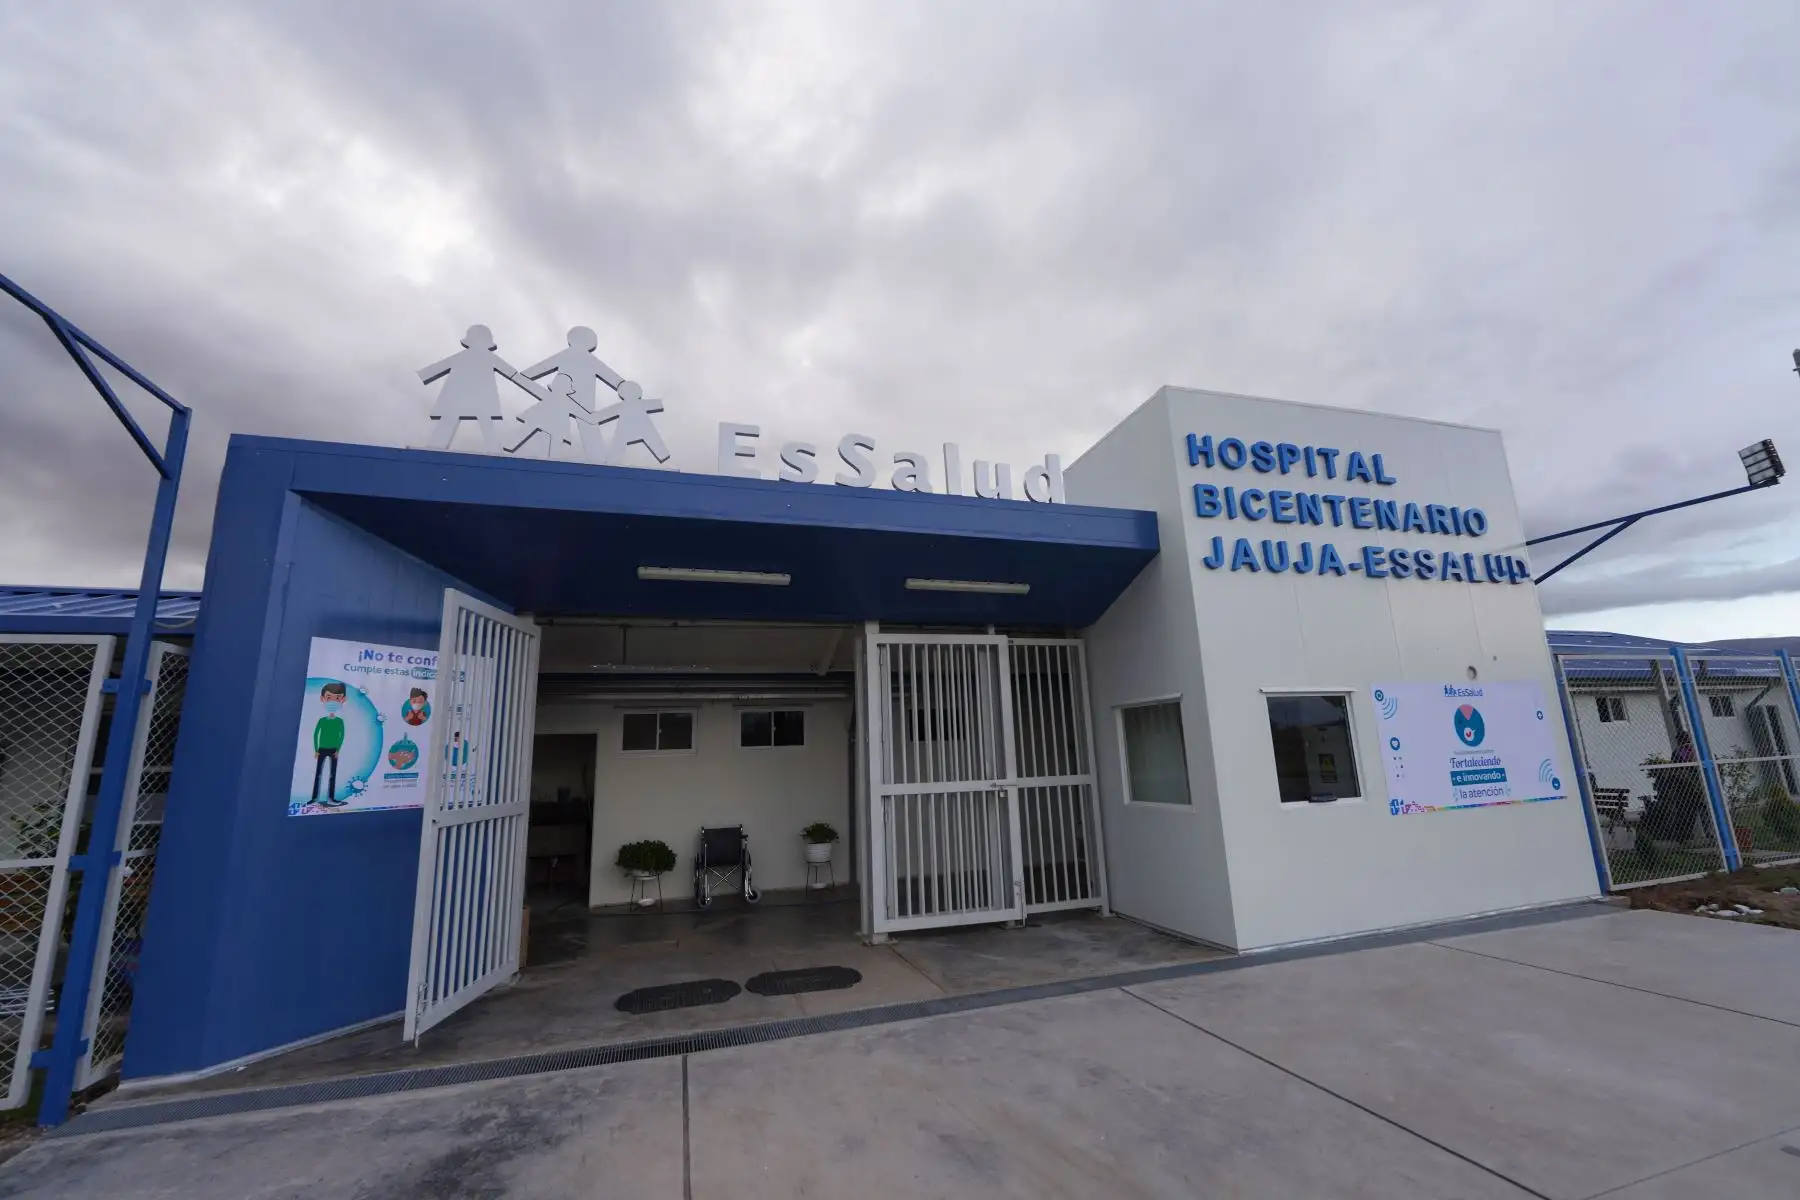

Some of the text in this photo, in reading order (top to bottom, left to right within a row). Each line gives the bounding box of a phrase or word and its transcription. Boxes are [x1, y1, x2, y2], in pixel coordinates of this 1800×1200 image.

[718, 422, 1066, 504] EsSalud
[1186, 432, 1397, 485] HOSPITAL
[1193, 483, 1488, 538] BICENTENARIO
[1203, 536, 1532, 585] JAUJA-ESSALUD
[358, 649, 439, 667] ¡No te conf
[344, 663, 382, 676] Cumple
[384, 666, 410, 676] estas
[412, 668, 438, 678] indic
[1457, 687, 1484, 697] EsSalud
[1449, 756, 1502, 769] Fortaleciendo
[1456, 771, 1502, 783] e innovando
[1460, 786, 1505, 799] la atención
